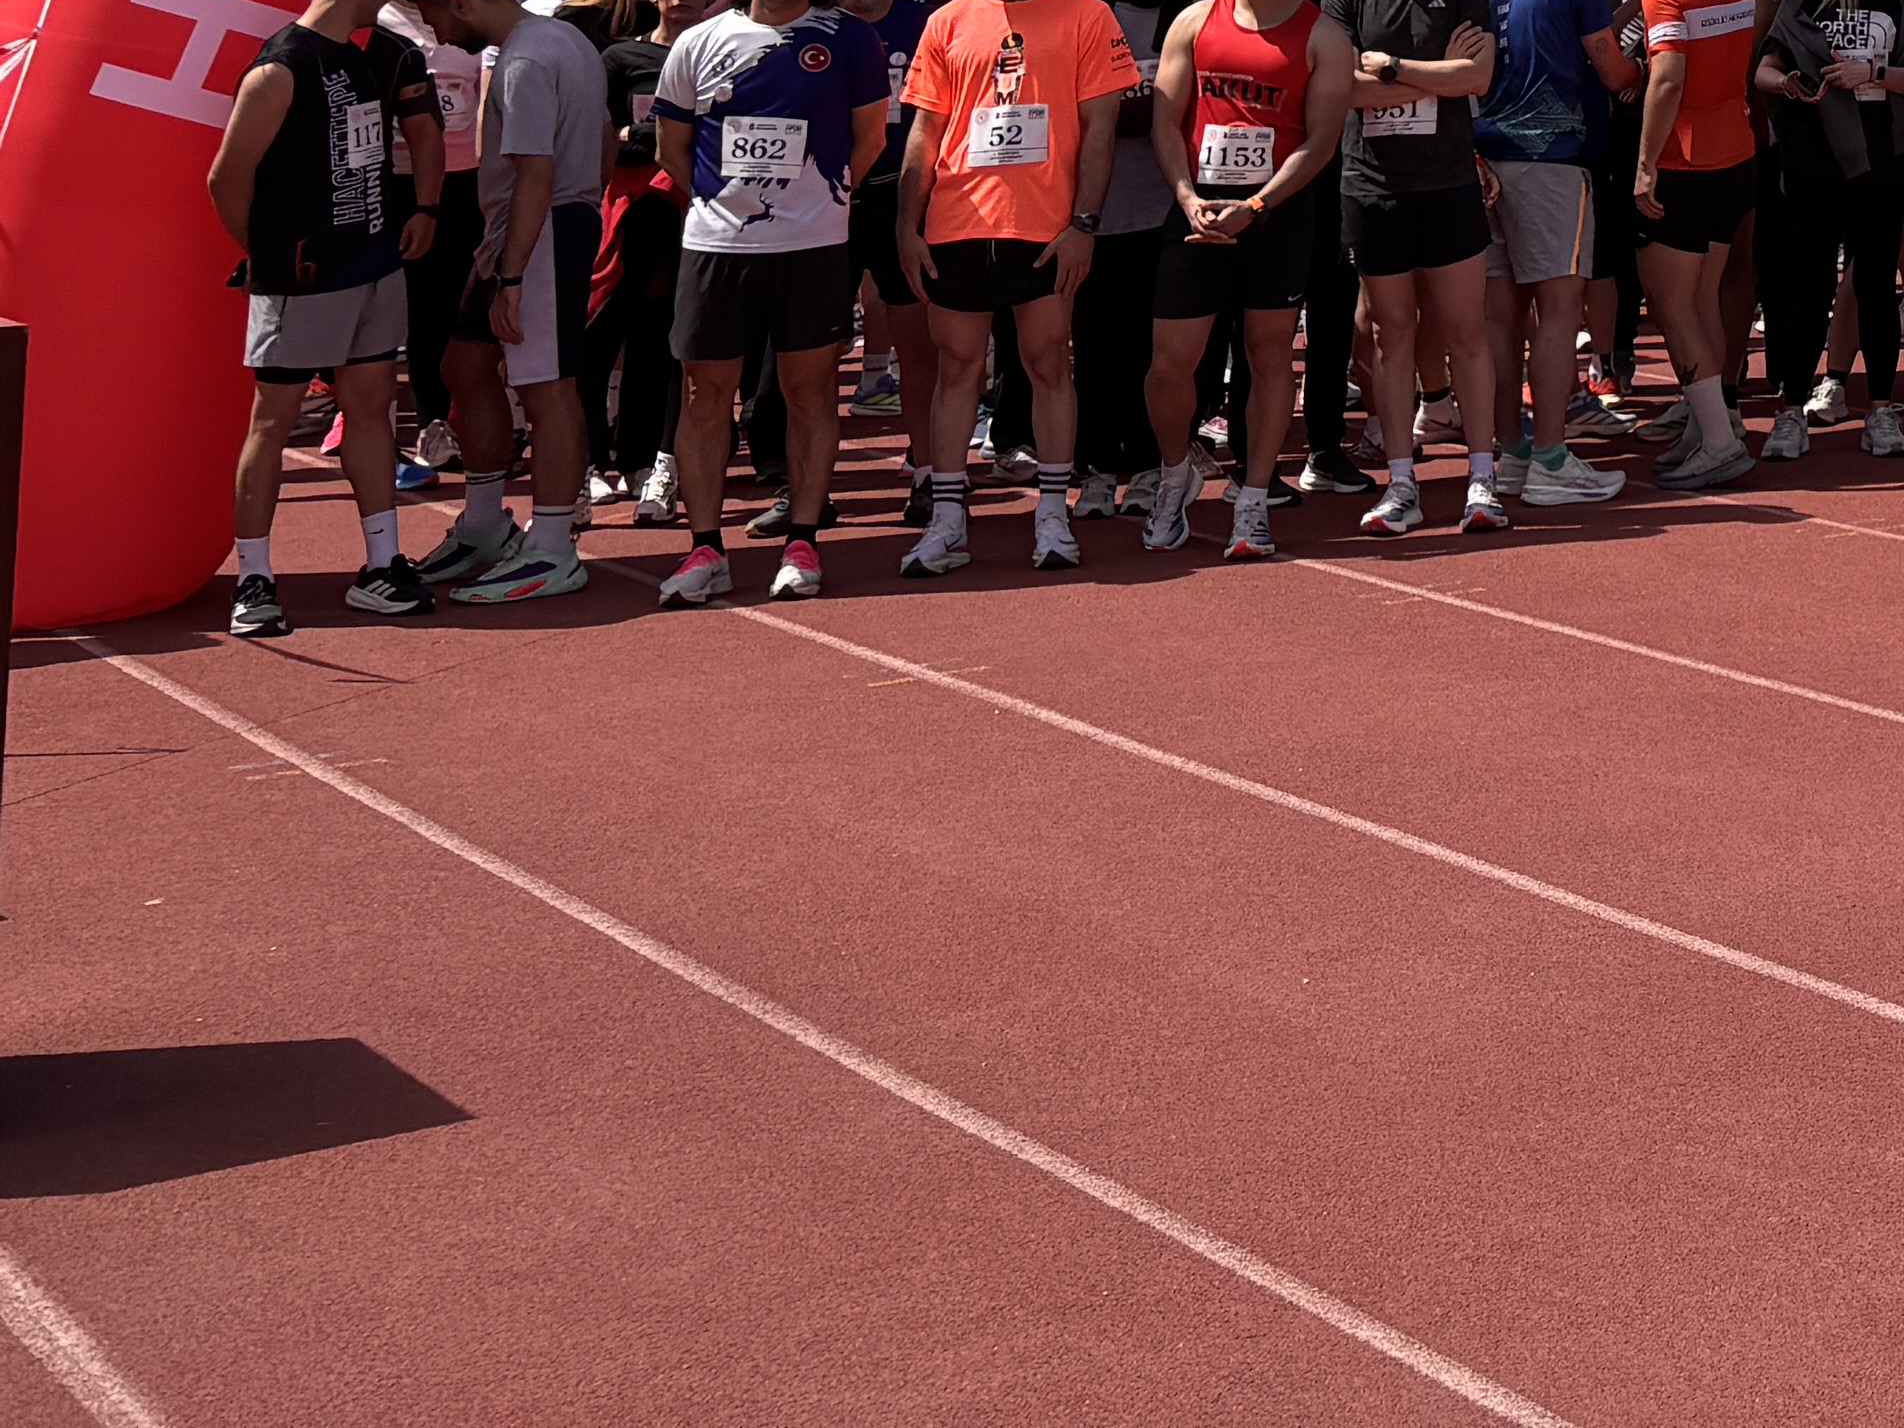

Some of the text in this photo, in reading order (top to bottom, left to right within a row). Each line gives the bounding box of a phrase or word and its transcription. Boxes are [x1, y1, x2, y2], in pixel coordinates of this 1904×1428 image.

[1836, 8, 1870, 22] THE
[1815, 20, 1870, 35] ORTH
[354, 122, 382, 148] 117
[988, 124, 1023, 147] 52
[731, 137, 787, 160] 862
[1203, 145, 1267, 168] 1153
[366, 152, 384, 235] RUNNI
